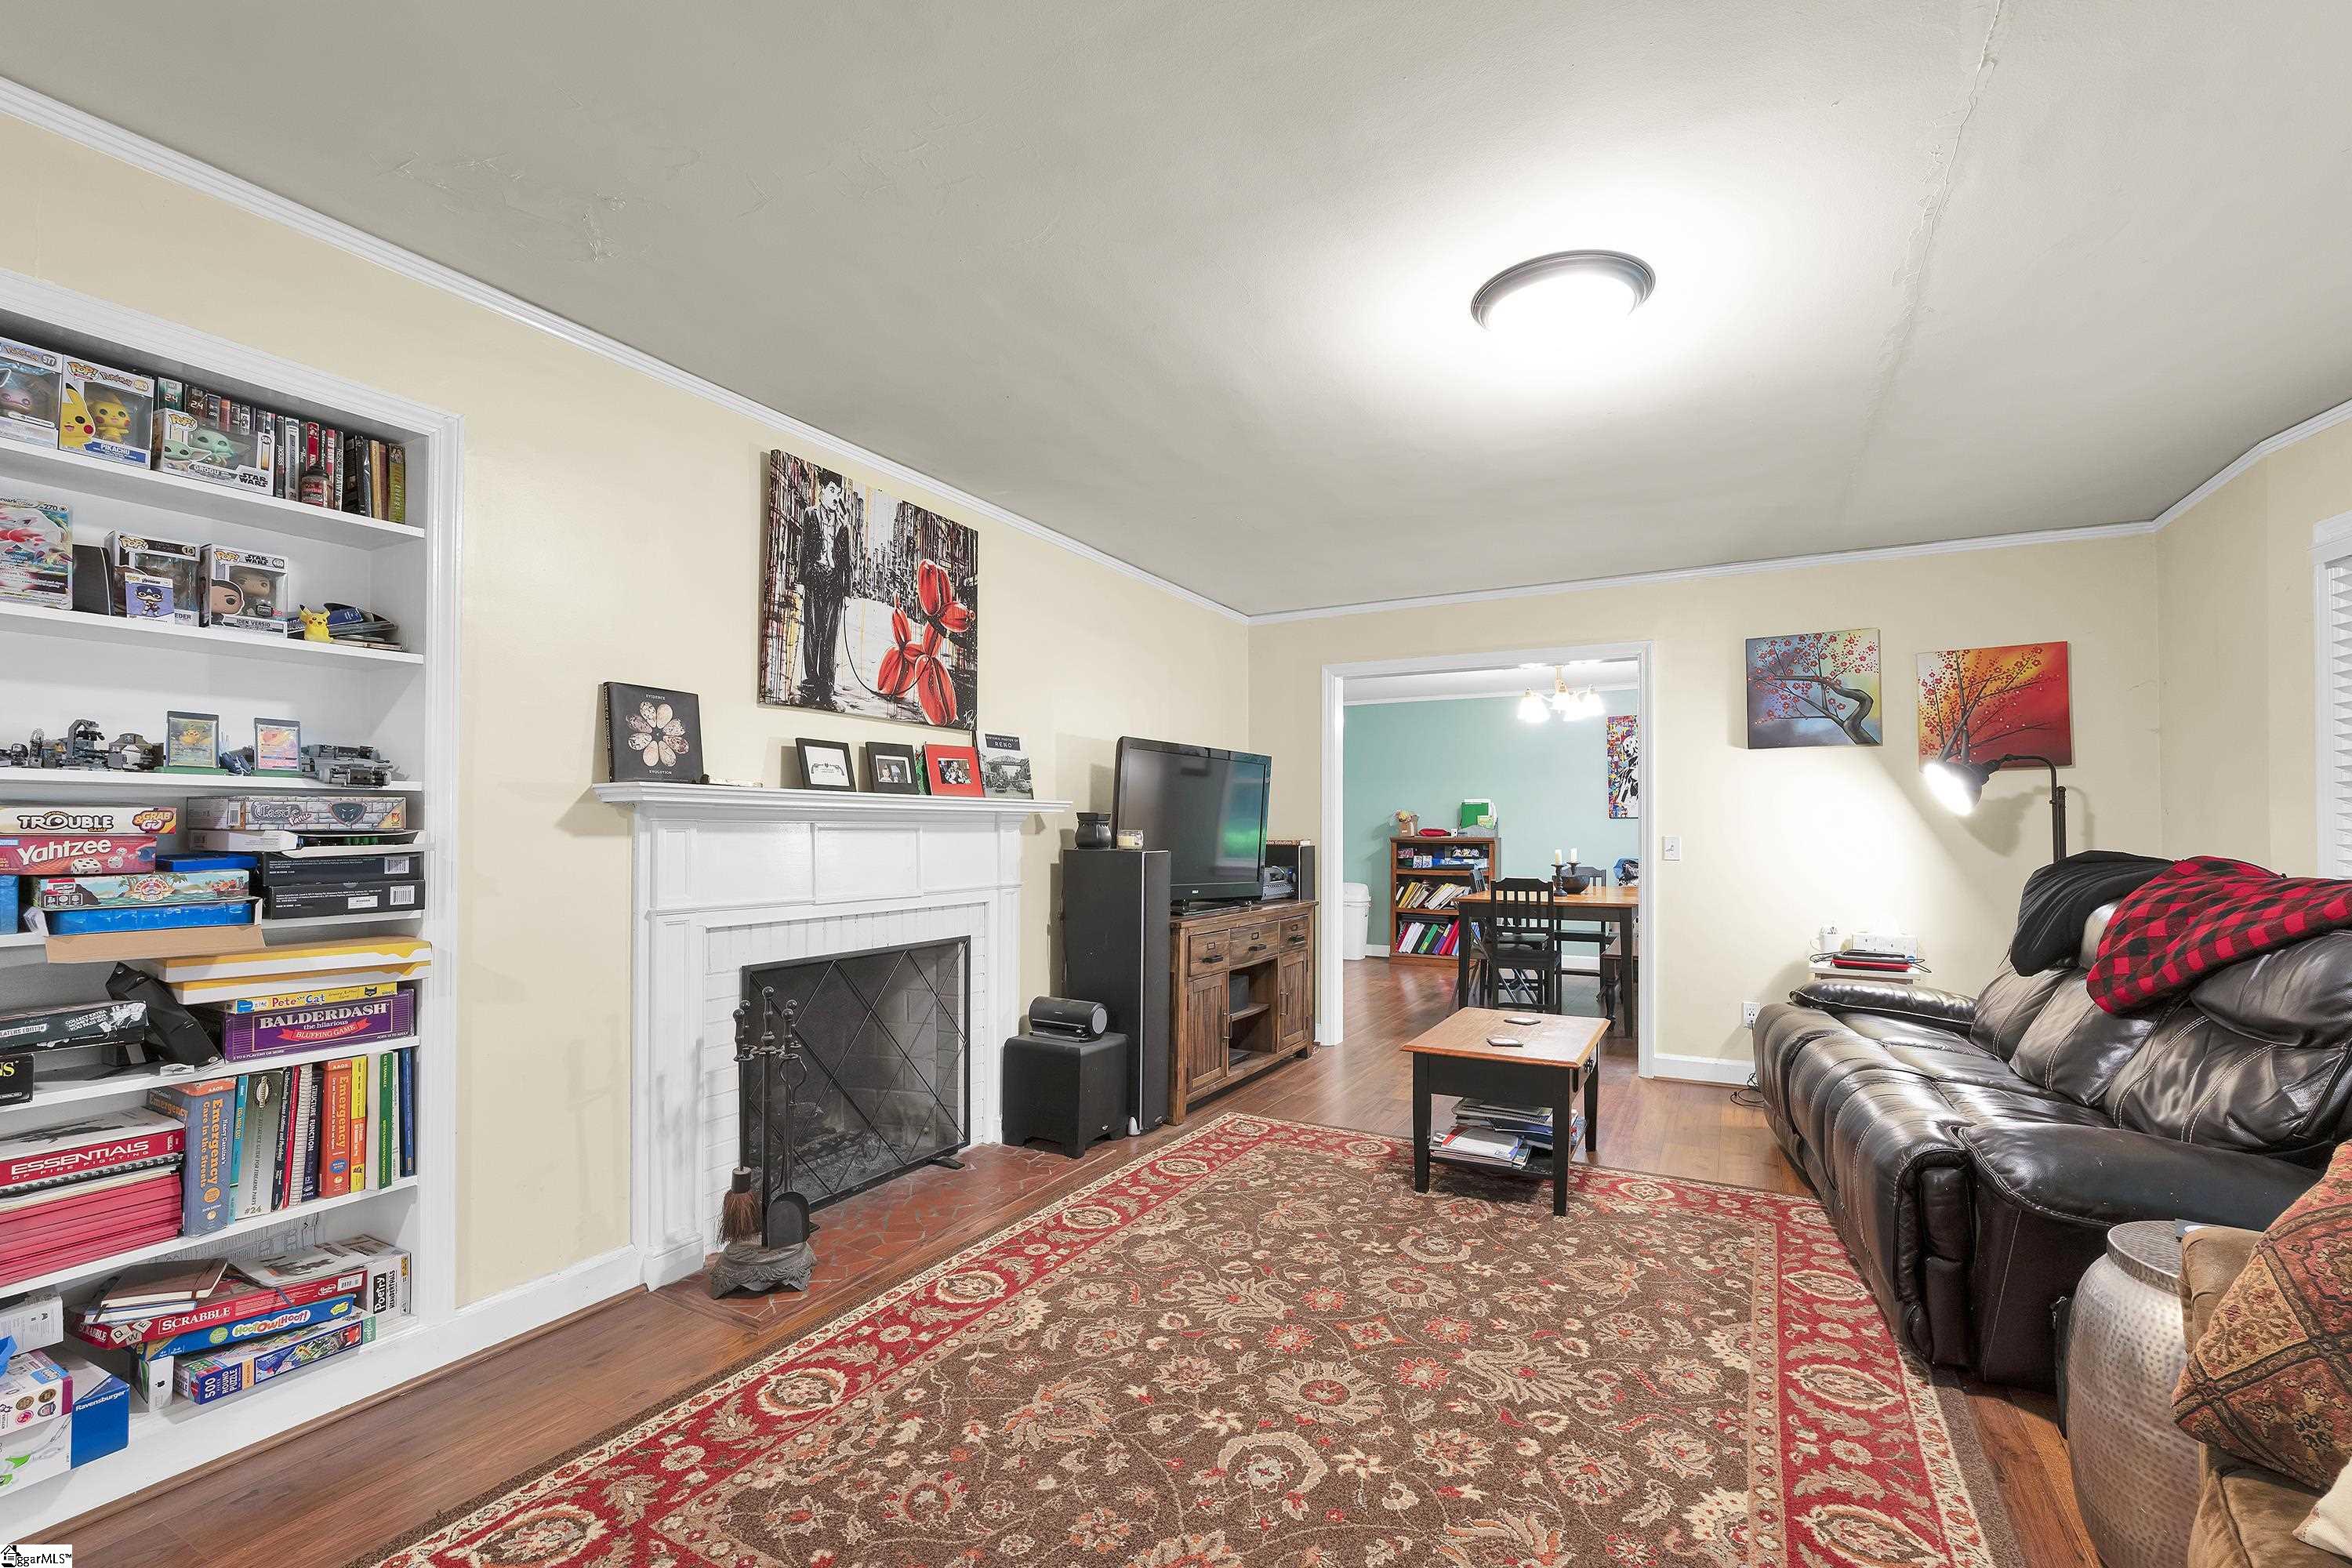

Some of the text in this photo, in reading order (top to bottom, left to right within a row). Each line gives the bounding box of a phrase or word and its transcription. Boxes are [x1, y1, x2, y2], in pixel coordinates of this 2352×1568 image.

[42, 356, 56, 367] 577
[165, 394, 178, 402] 24
[191, 401, 204, 409] 24
[100, 443, 130, 456] PIKACHU
[194, 465, 220, 475] GROGU
[239, 477, 268, 488] WARS
[17, 812, 114, 830] TROUBLE
[143, 811, 172, 821] GRAB
[142, 819, 162, 830] GO
[16, 839, 112, 866] Yahtzee
[272, 997, 296, 1007] Pete
[306, 994, 325, 1004] Cat
[260, 1003, 387, 1029] BALDERDASH
[296, 1025, 356, 1039] BLUFFING GAME
[317, 1020, 348, 1029] hilarious
[337, 1076, 350, 1148] Emergency
[208, 1098, 223, 1185] Emergency
[11, 1141, 150, 1175] ESSENTIALS
[40, 1165, 74, 1174] FIRE
[83, 1151, 150, 1167] FIGHTING
[245, 1206, 262, 1214] #24
[374, 1276, 387, 1312] Poetry
[162, 1306, 231, 1331] SCRABBLE
[205, 1377, 216, 1399] 500
[229, 1368, 238, 1392] PUZZLE
[75, 1389, 126, 1411] Ravensburger
